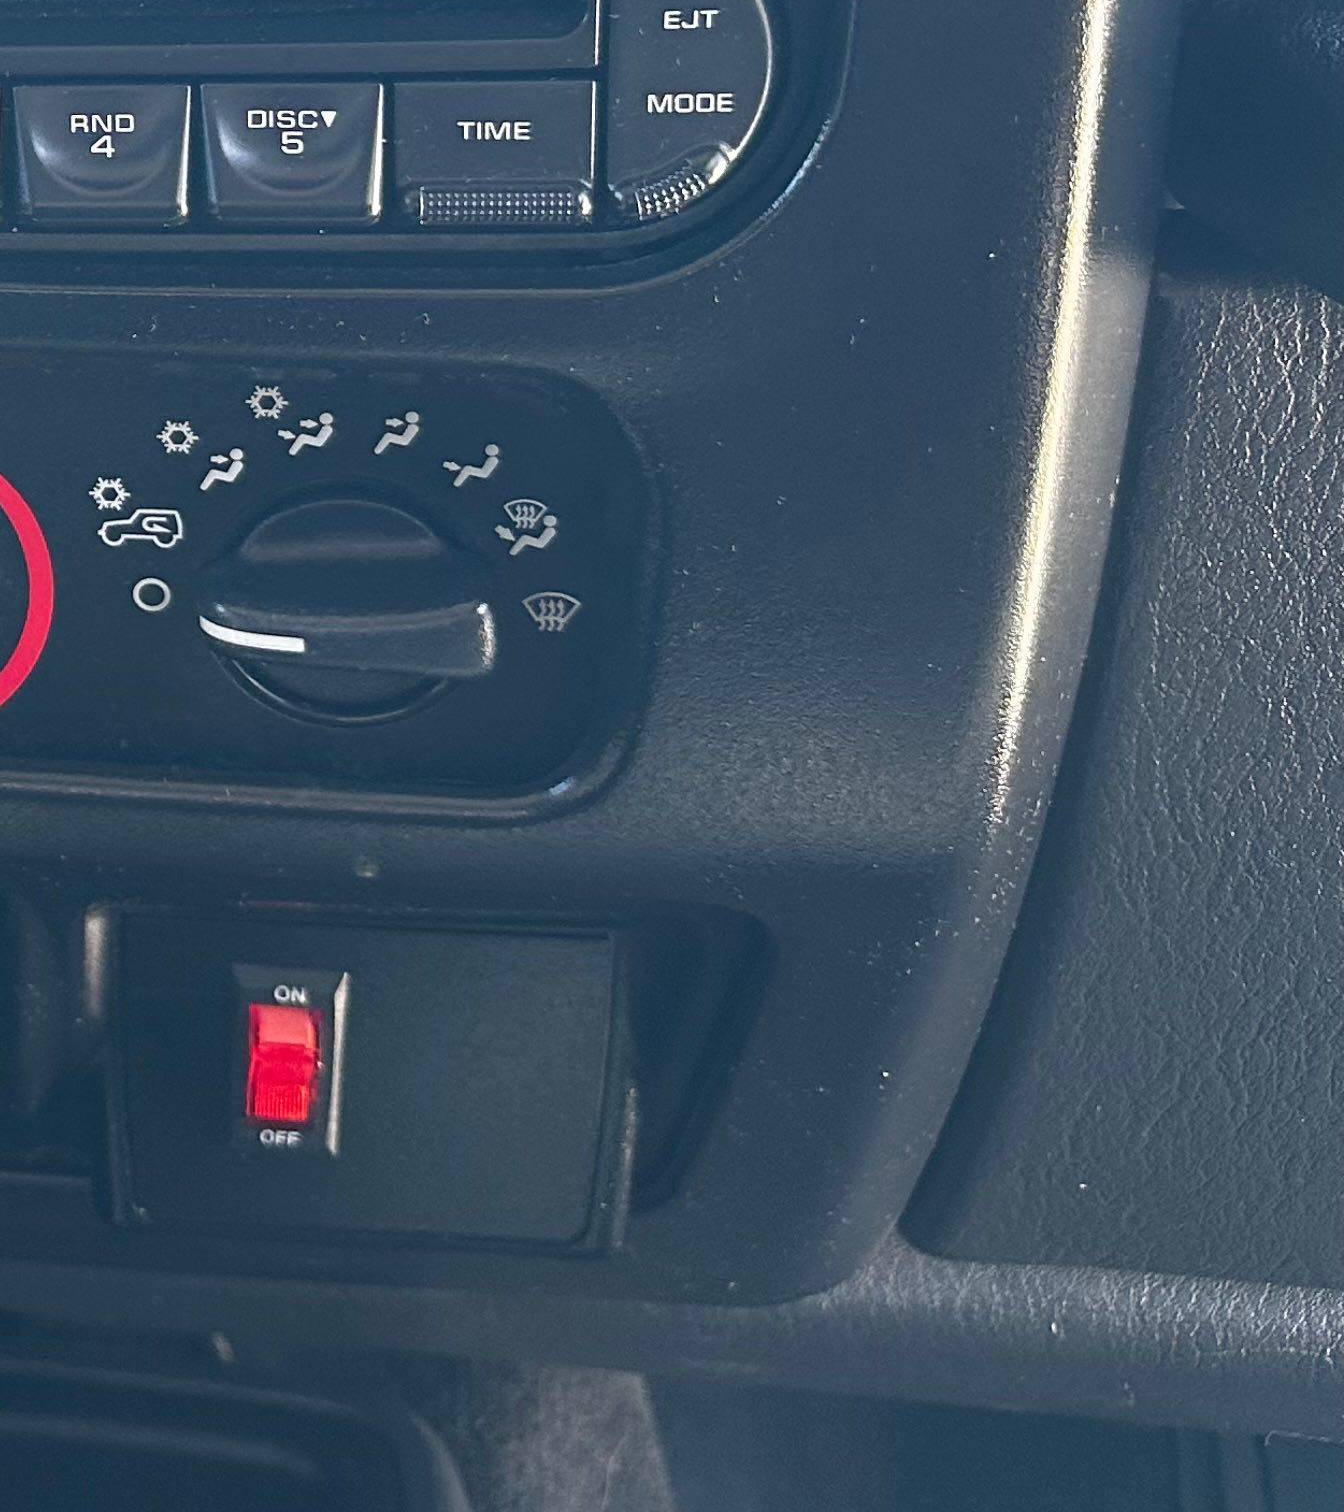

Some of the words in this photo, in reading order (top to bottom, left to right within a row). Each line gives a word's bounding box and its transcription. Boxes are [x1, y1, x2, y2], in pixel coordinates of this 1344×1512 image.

[662, 9, 720, 30] EJT
[647, 93, 734, 114] MODE
[69, 113, 136, 135] RND
[247, 109, 321, 132] DISC
[456, 121, 532, 141] TIME
[88, 135, 116, 160] 4
[280, 131, 305, 156] 5
[273, 984, 308, 1004] ON
[259, 1128, 302, 1146] OFF
